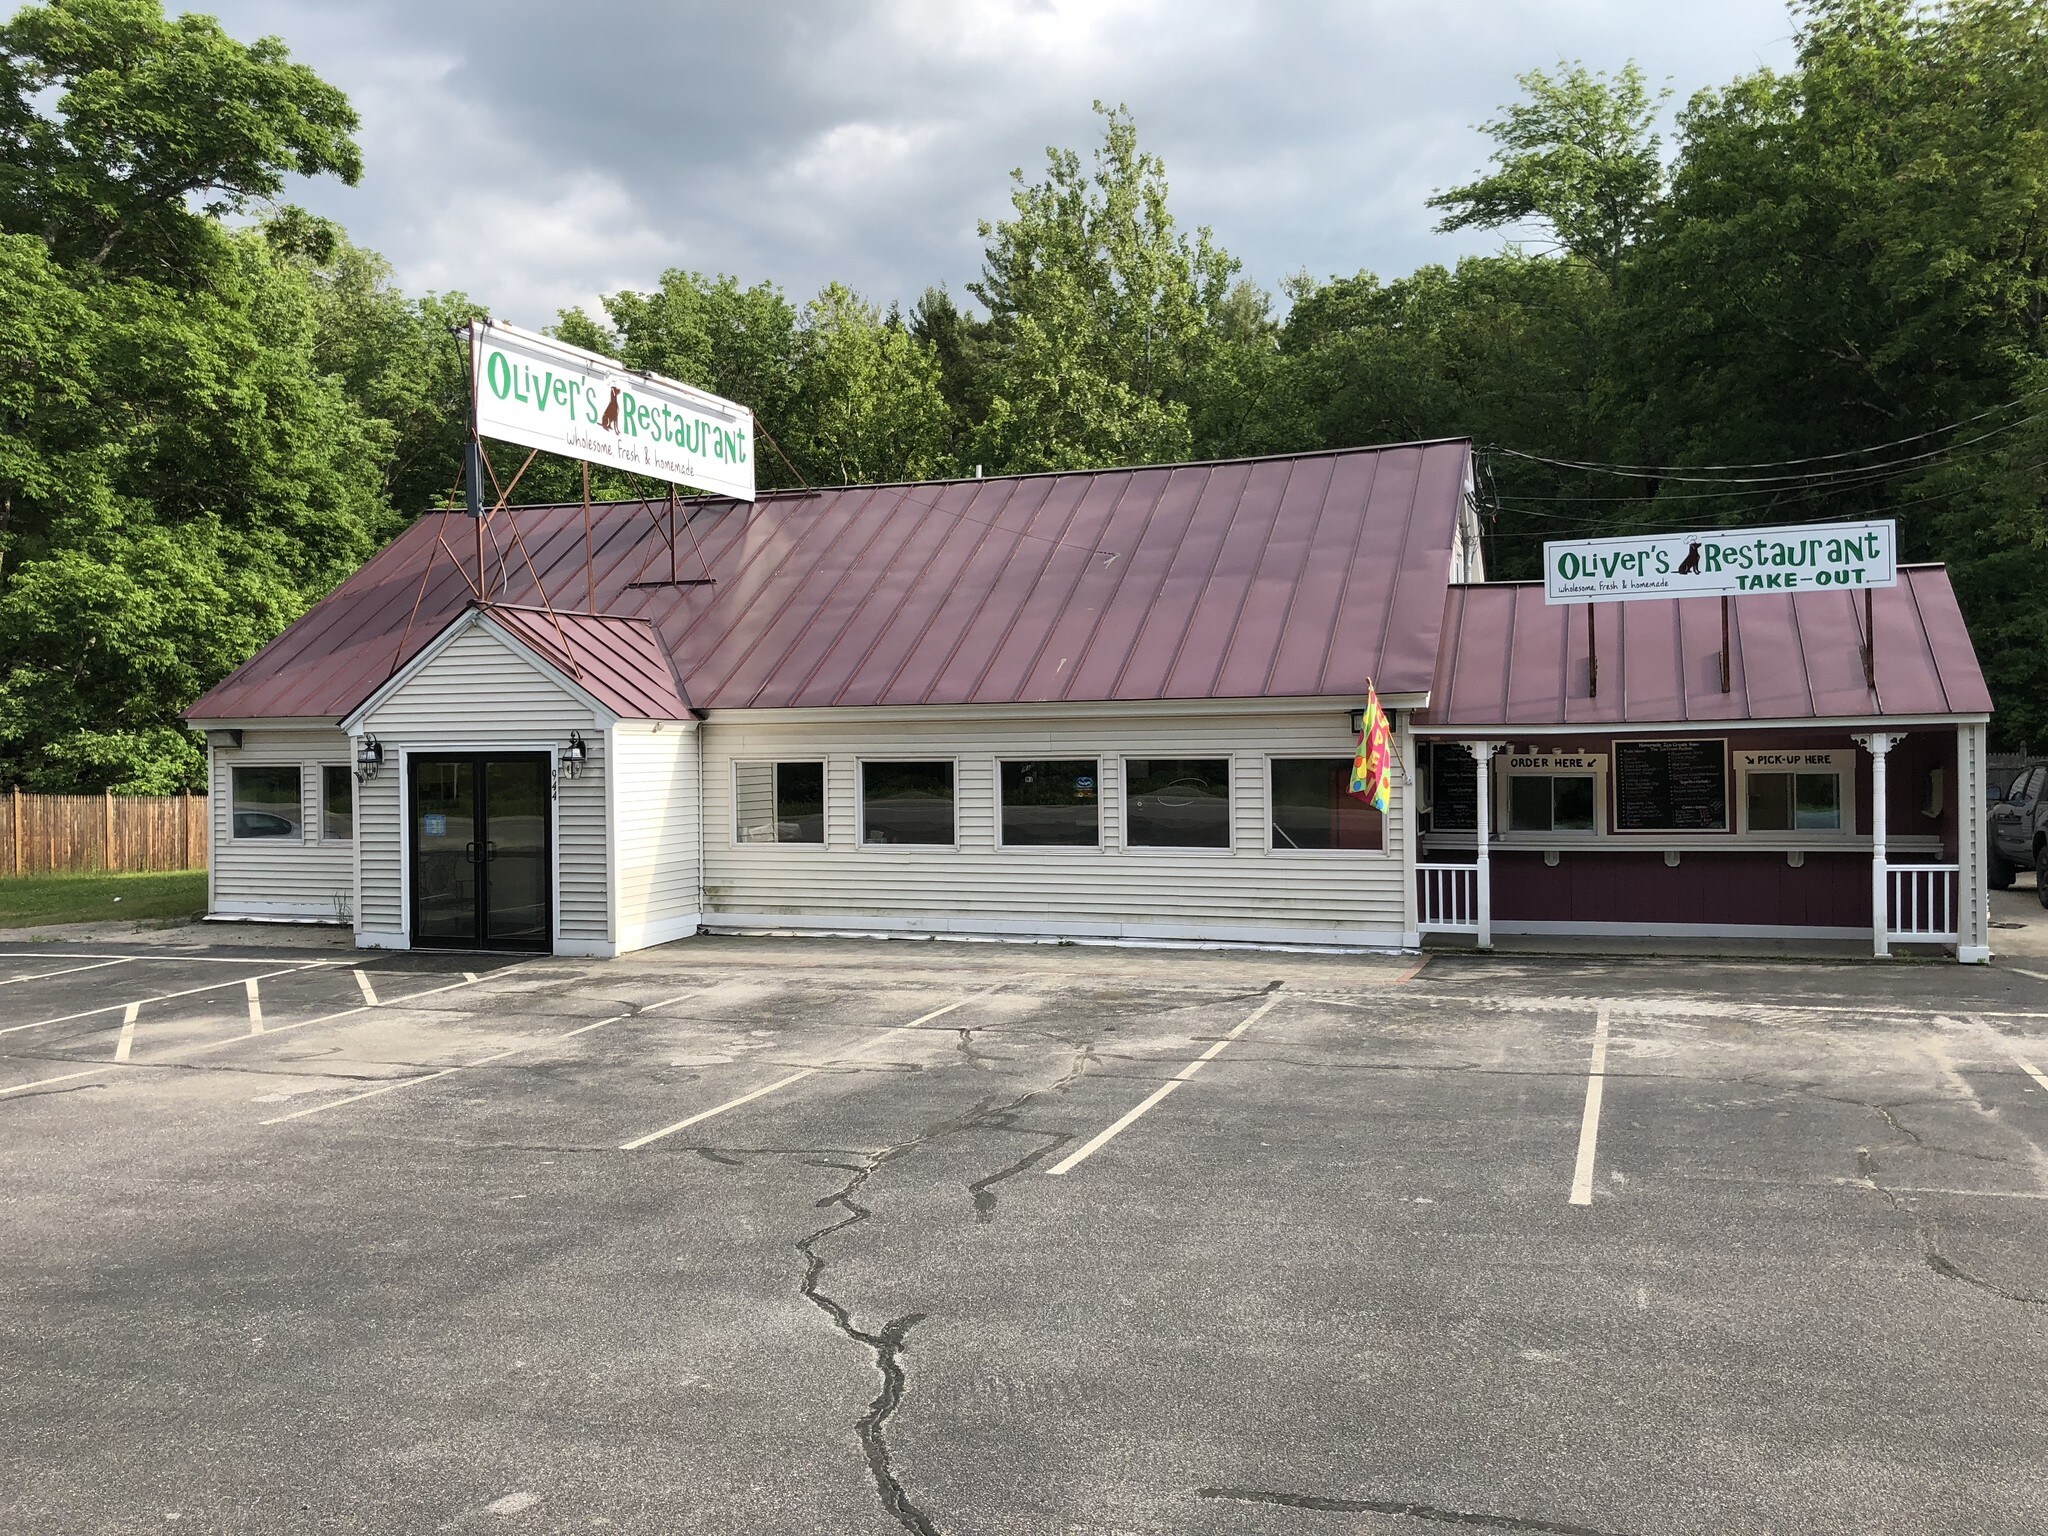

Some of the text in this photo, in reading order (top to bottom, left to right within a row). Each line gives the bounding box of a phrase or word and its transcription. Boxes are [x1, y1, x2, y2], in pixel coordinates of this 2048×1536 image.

[644, 446, 651, 465] &
[655, 449, 695, 477] homemade
[1622, 579, 1628, 589] &
[1631, 577, 1669, 589] homemade
[1735, 568, 1866, 590] TAKE-OUT
[1510, 758, 1583, 768] ORDER HERE
[1757, 755, 1832, 765] PICK-UP HERE
